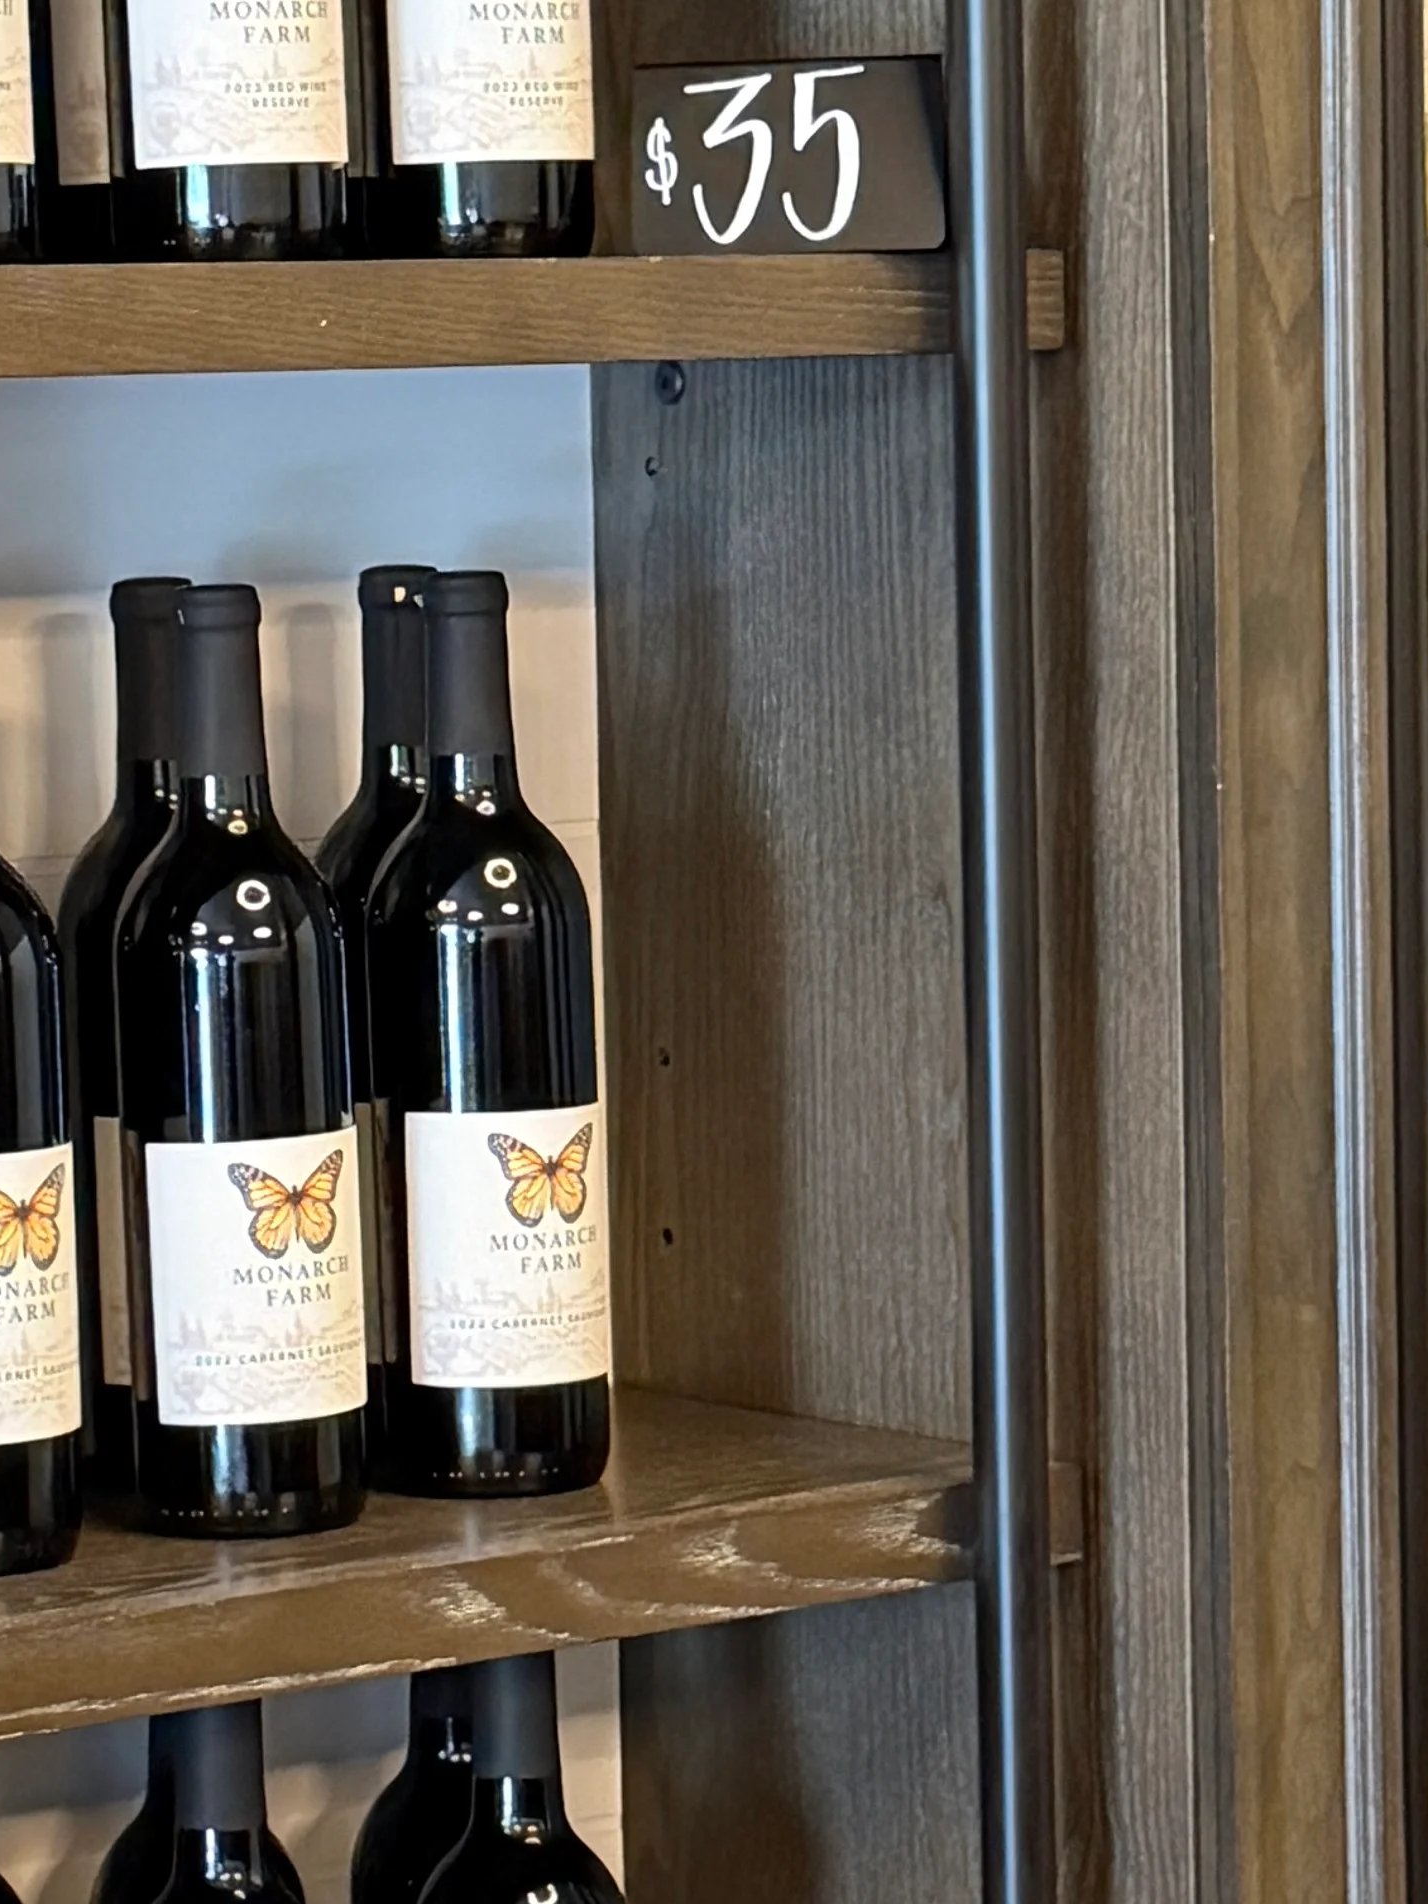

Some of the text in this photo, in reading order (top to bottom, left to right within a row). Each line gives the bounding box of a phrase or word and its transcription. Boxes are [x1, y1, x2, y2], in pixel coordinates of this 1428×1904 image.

[208, 0, 329, 22] MONARCH
[468, 2, 581, 22] MONARCH
[242, 25, 311, 45] FARM
[500, 26, 565, 46] FARM
[645, 65, 865, 245] $35
[521, 1250, 583, 1275] FARM
[266, 1282, 332, 1308] FARM
